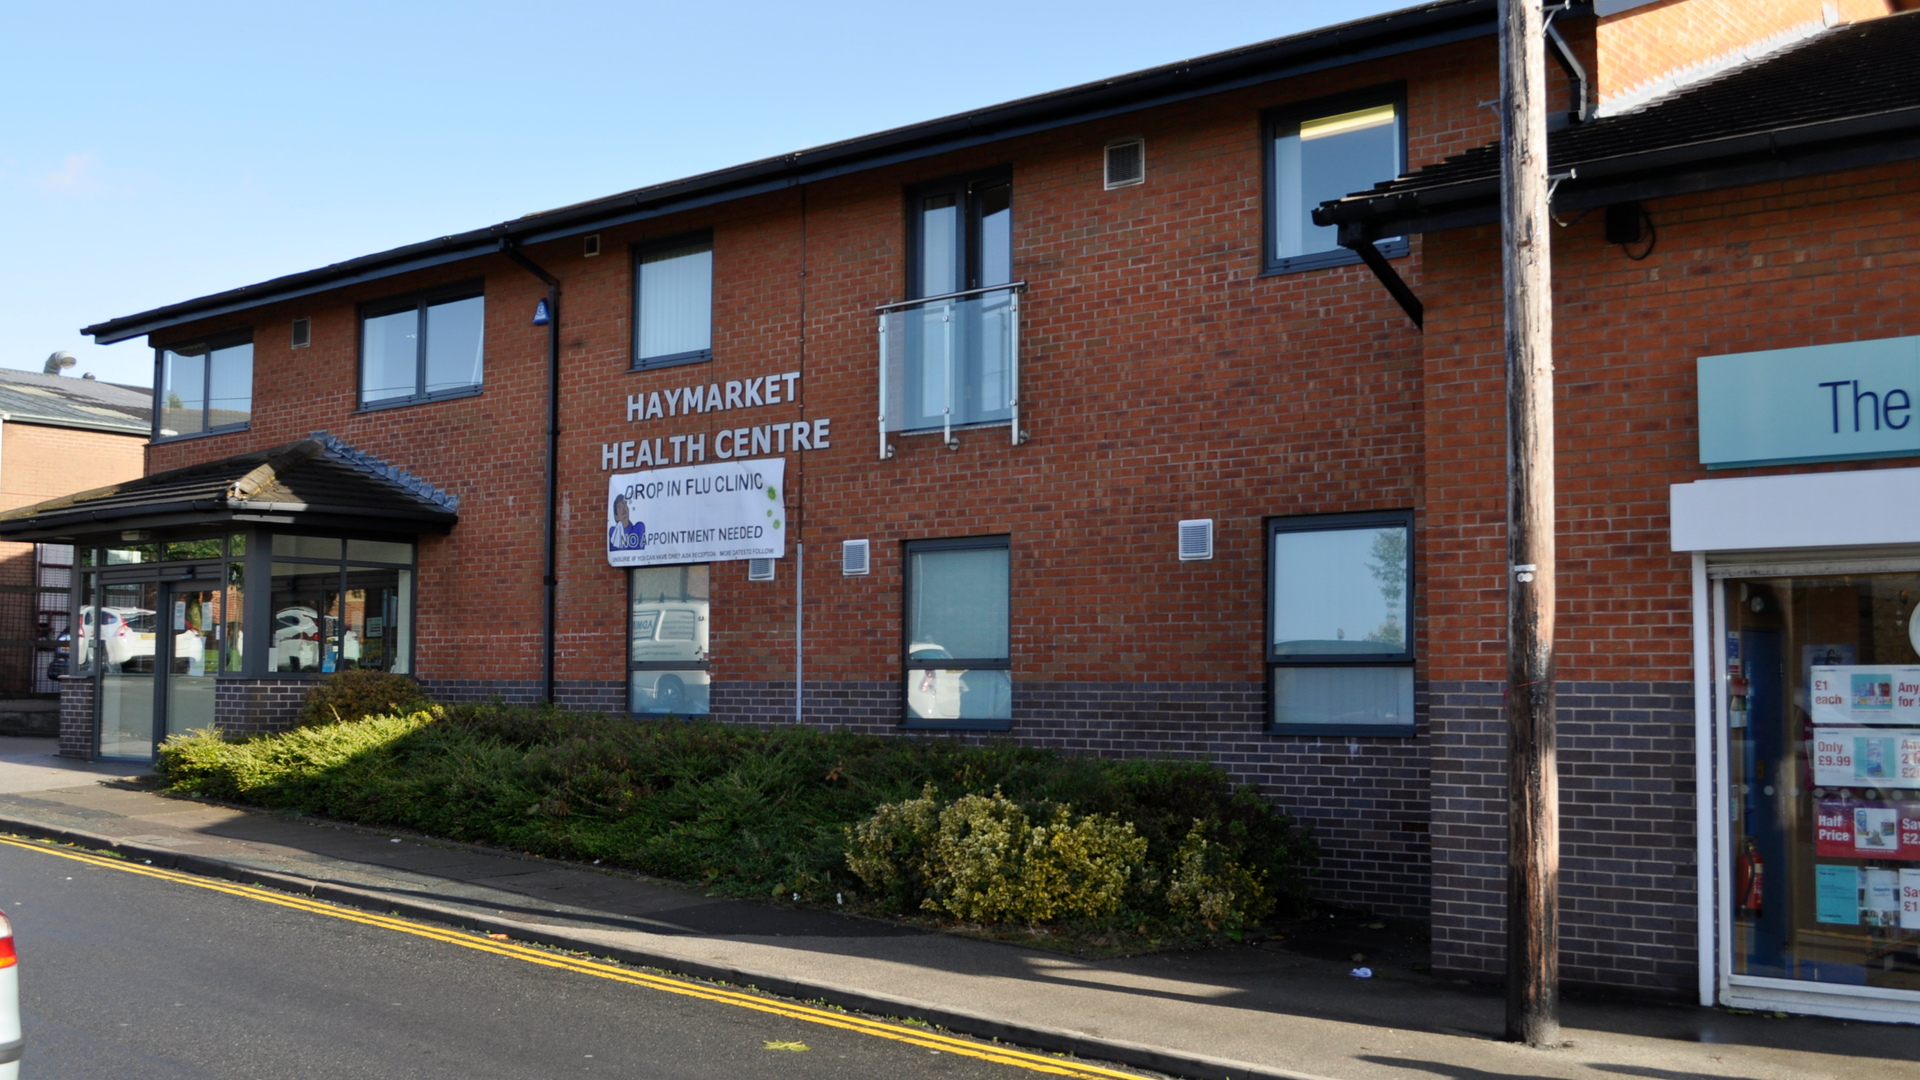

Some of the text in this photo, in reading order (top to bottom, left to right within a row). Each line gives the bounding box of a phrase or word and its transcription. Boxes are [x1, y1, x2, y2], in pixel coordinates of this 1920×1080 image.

[626, 371, 801, 422] HAYMARKET
[1818, 379, 1911, 434] The
[601, 418, 831, 471] HEALTH CENTRE
[624, 472, 763, 500] DROP IN FLU CLINIC
[620, 525, 763, 548] NO APPOINTMENT NEEDED
[1815, 680, 1828, 691] £1
[1898, 682, 1919, 695] Any
[1815, 694, 1842, 705] each
[1898, 696, 1914, 707] for
[1817, 741, 1843, 754] Only
[1818, 755, 1851, 767] £9.99
[1901, 753, 1909, 764] 2
[1818, 815, 1843, 827] Half
[1818, 828, 1850, 841] Price
[1903, 886, 1920, 898] Sa
